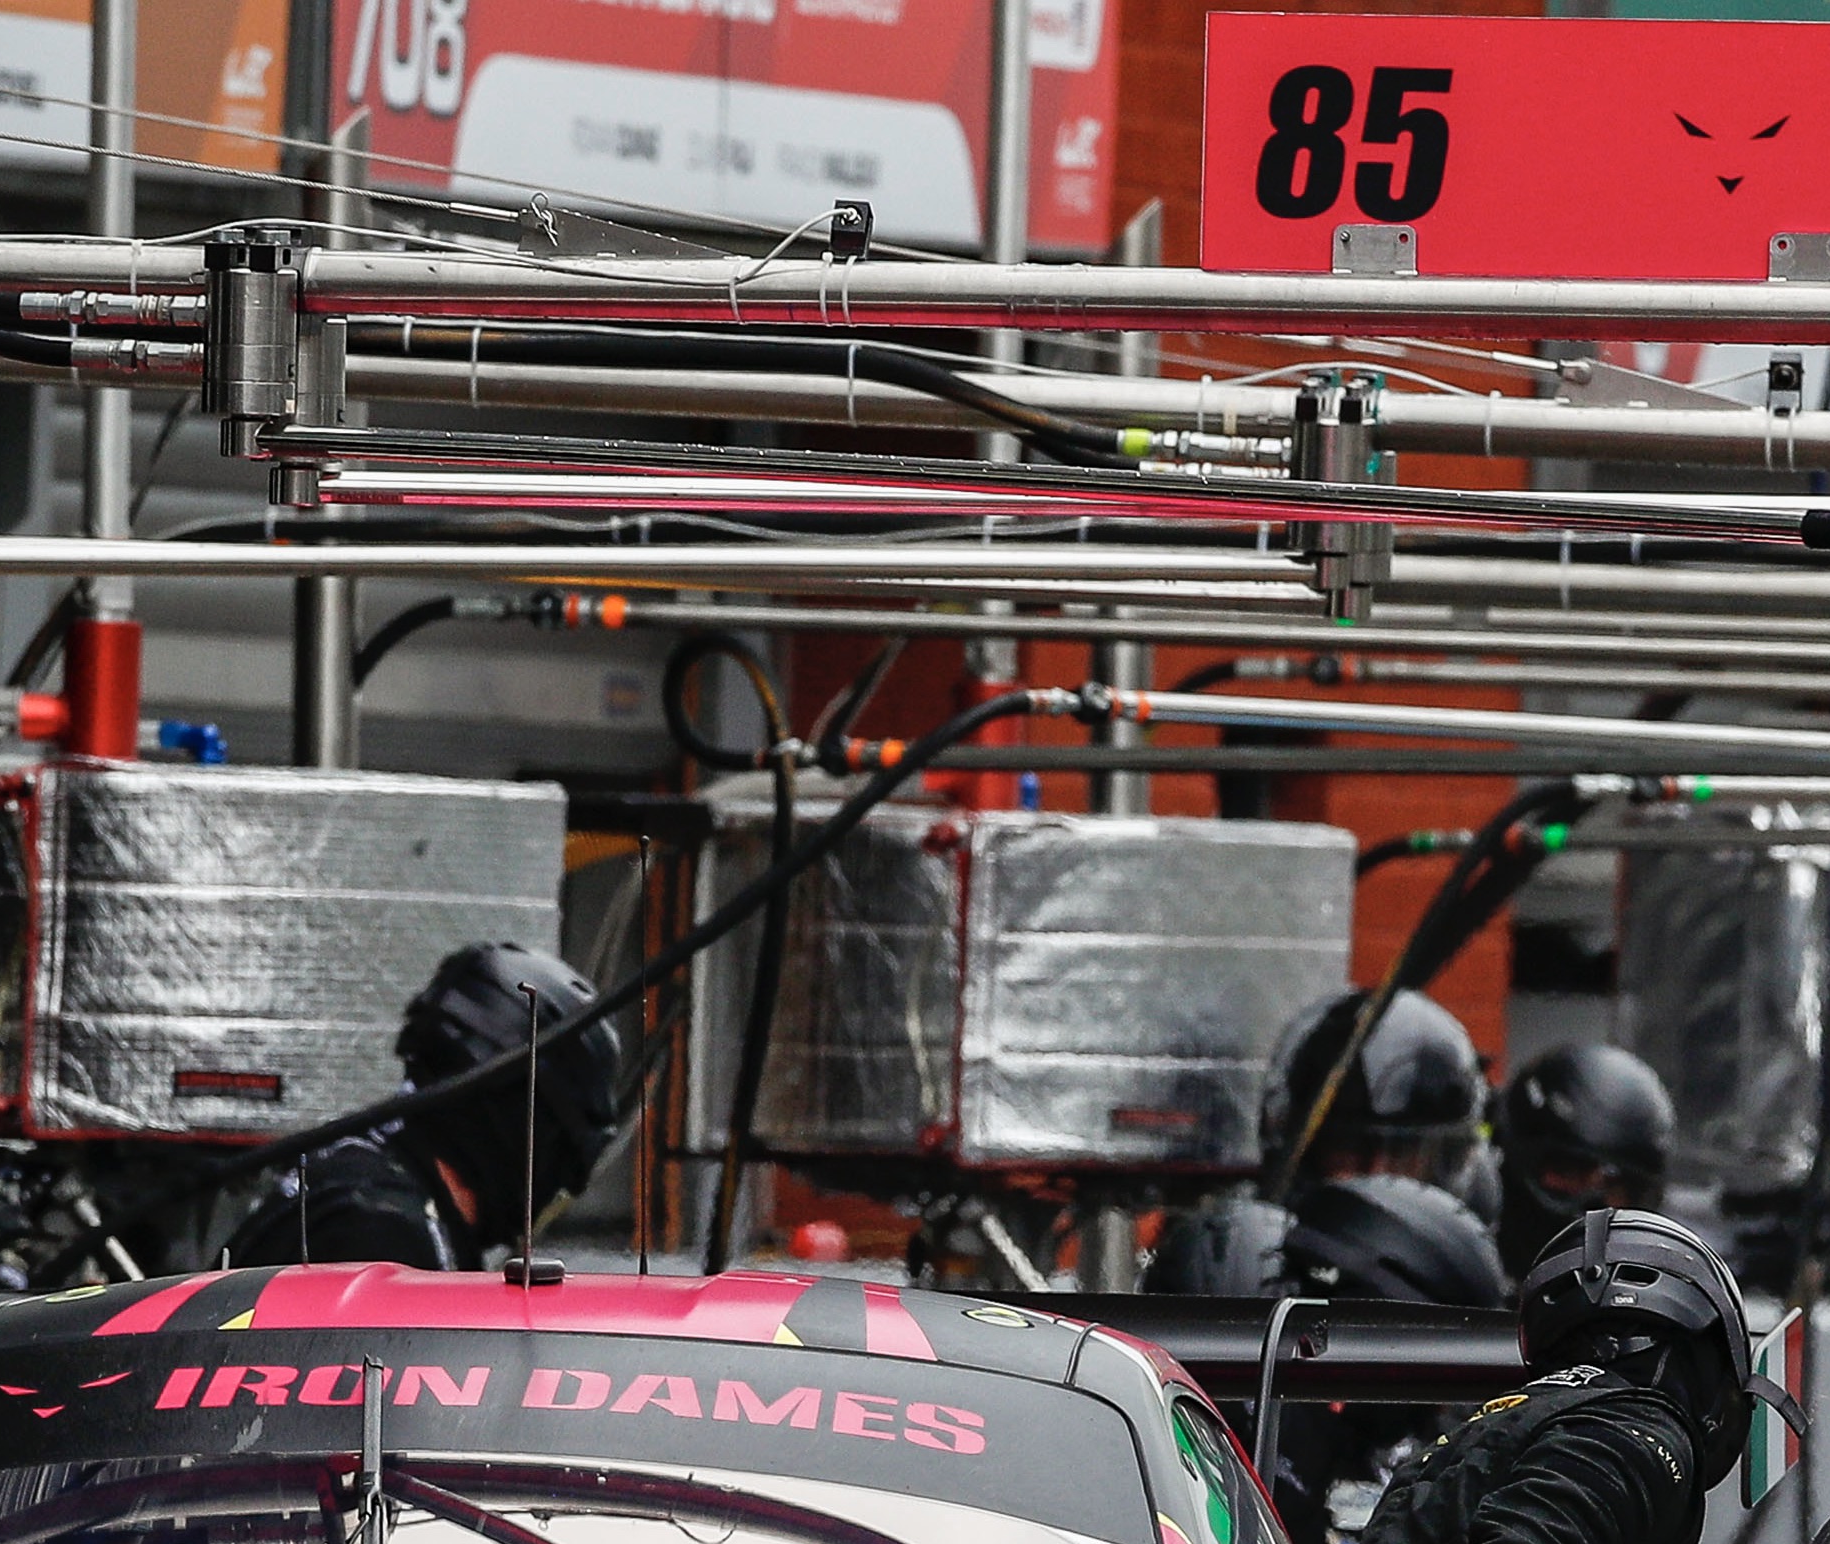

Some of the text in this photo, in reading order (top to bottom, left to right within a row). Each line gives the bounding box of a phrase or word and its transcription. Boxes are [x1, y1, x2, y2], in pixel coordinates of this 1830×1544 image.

[1255, 65, 1454, 222] 85
[153, 1364, 989, 1457] IRON DAMES
